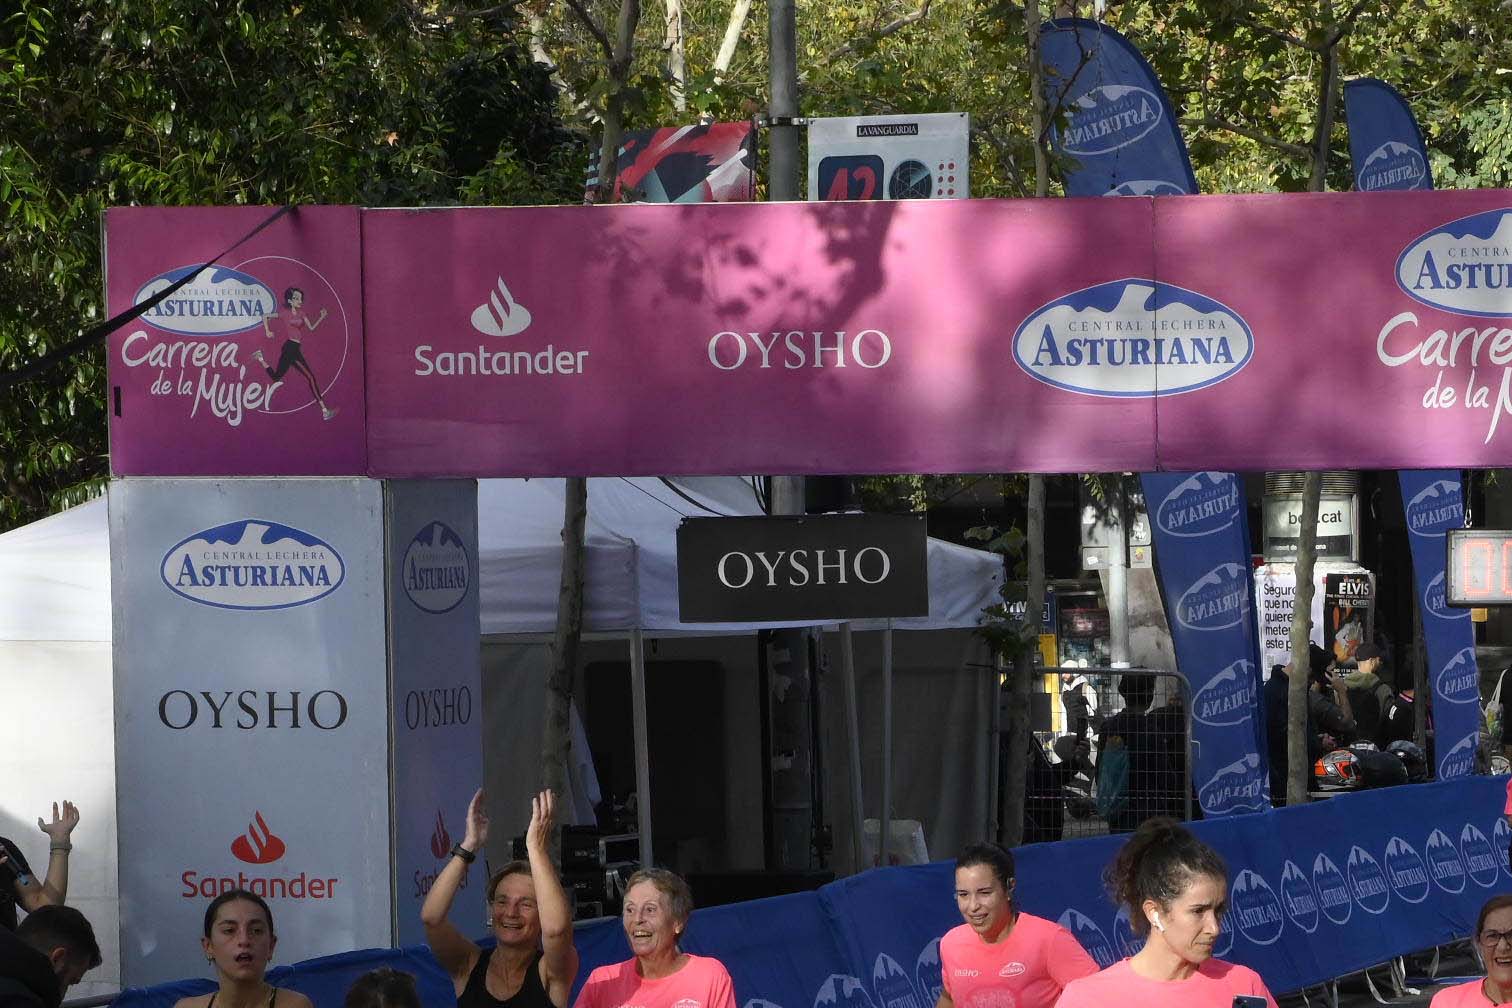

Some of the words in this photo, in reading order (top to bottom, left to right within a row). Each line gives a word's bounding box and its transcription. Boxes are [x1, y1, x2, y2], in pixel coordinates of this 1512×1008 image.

[143, 289, 264, 319] ASTURIANA
[1068, 320, 1144, 332] CENTRAL
[1150, 319, 1228, 331] LECHERA
[121, 330, 237, 368] Carrera
[414, 344, 589, 376] Santander
[708, 329, 892, 371] OYSHO
[1031, 323, 1235, 369] ASTURIANA
[150, 369, 172, 396] de
[177, 372, 193, 397] la
[191, 364, 283, 427] Mujer
[1422, 370, 1457, 410] de
[1464, 370, 1490, 409] la
[175, 554, 332, 588] ASTURIANA
[203, 551, 263, 560] CENTRAL
[267, 551, 325, 560] LECHERA
[717, 547, 891, 589] OYSHO
[408, 559, 466, 591] ASTURIANA
[1339, 582, 1369, 595] ELVIS
[1265, 599, 1280, 611] que
[1265, 612, 1293, 624] quiere
[1266, 638, 1284, 648] este
[158, 690, 348, 730] OYSHO
[405, 686, 472, 730] OYSHO
[182, 871, 338, 898] Santander
